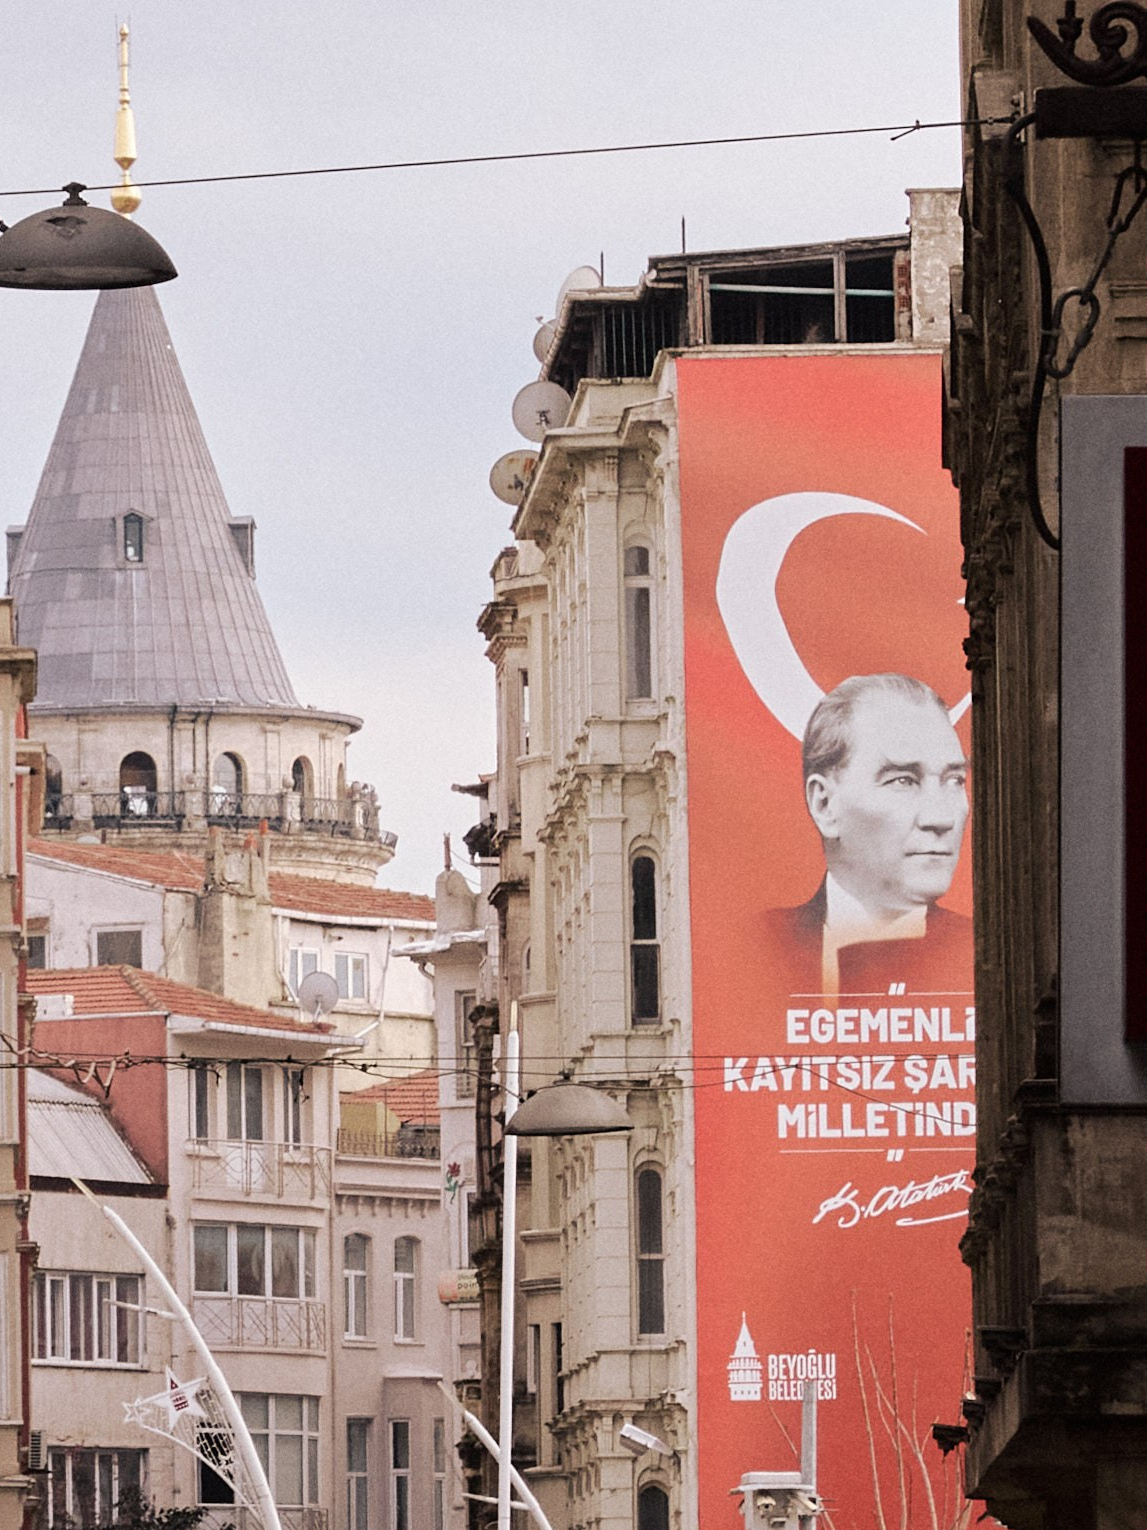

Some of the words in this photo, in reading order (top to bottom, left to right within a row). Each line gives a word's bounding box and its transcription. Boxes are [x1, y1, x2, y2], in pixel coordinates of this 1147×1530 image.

[723, 1055, 896, 1092] KAYITSIZ
[777, 1100, 976, 1139] MİLLETİND
[768, 1348, 837, 1380] BEYOĞLU
